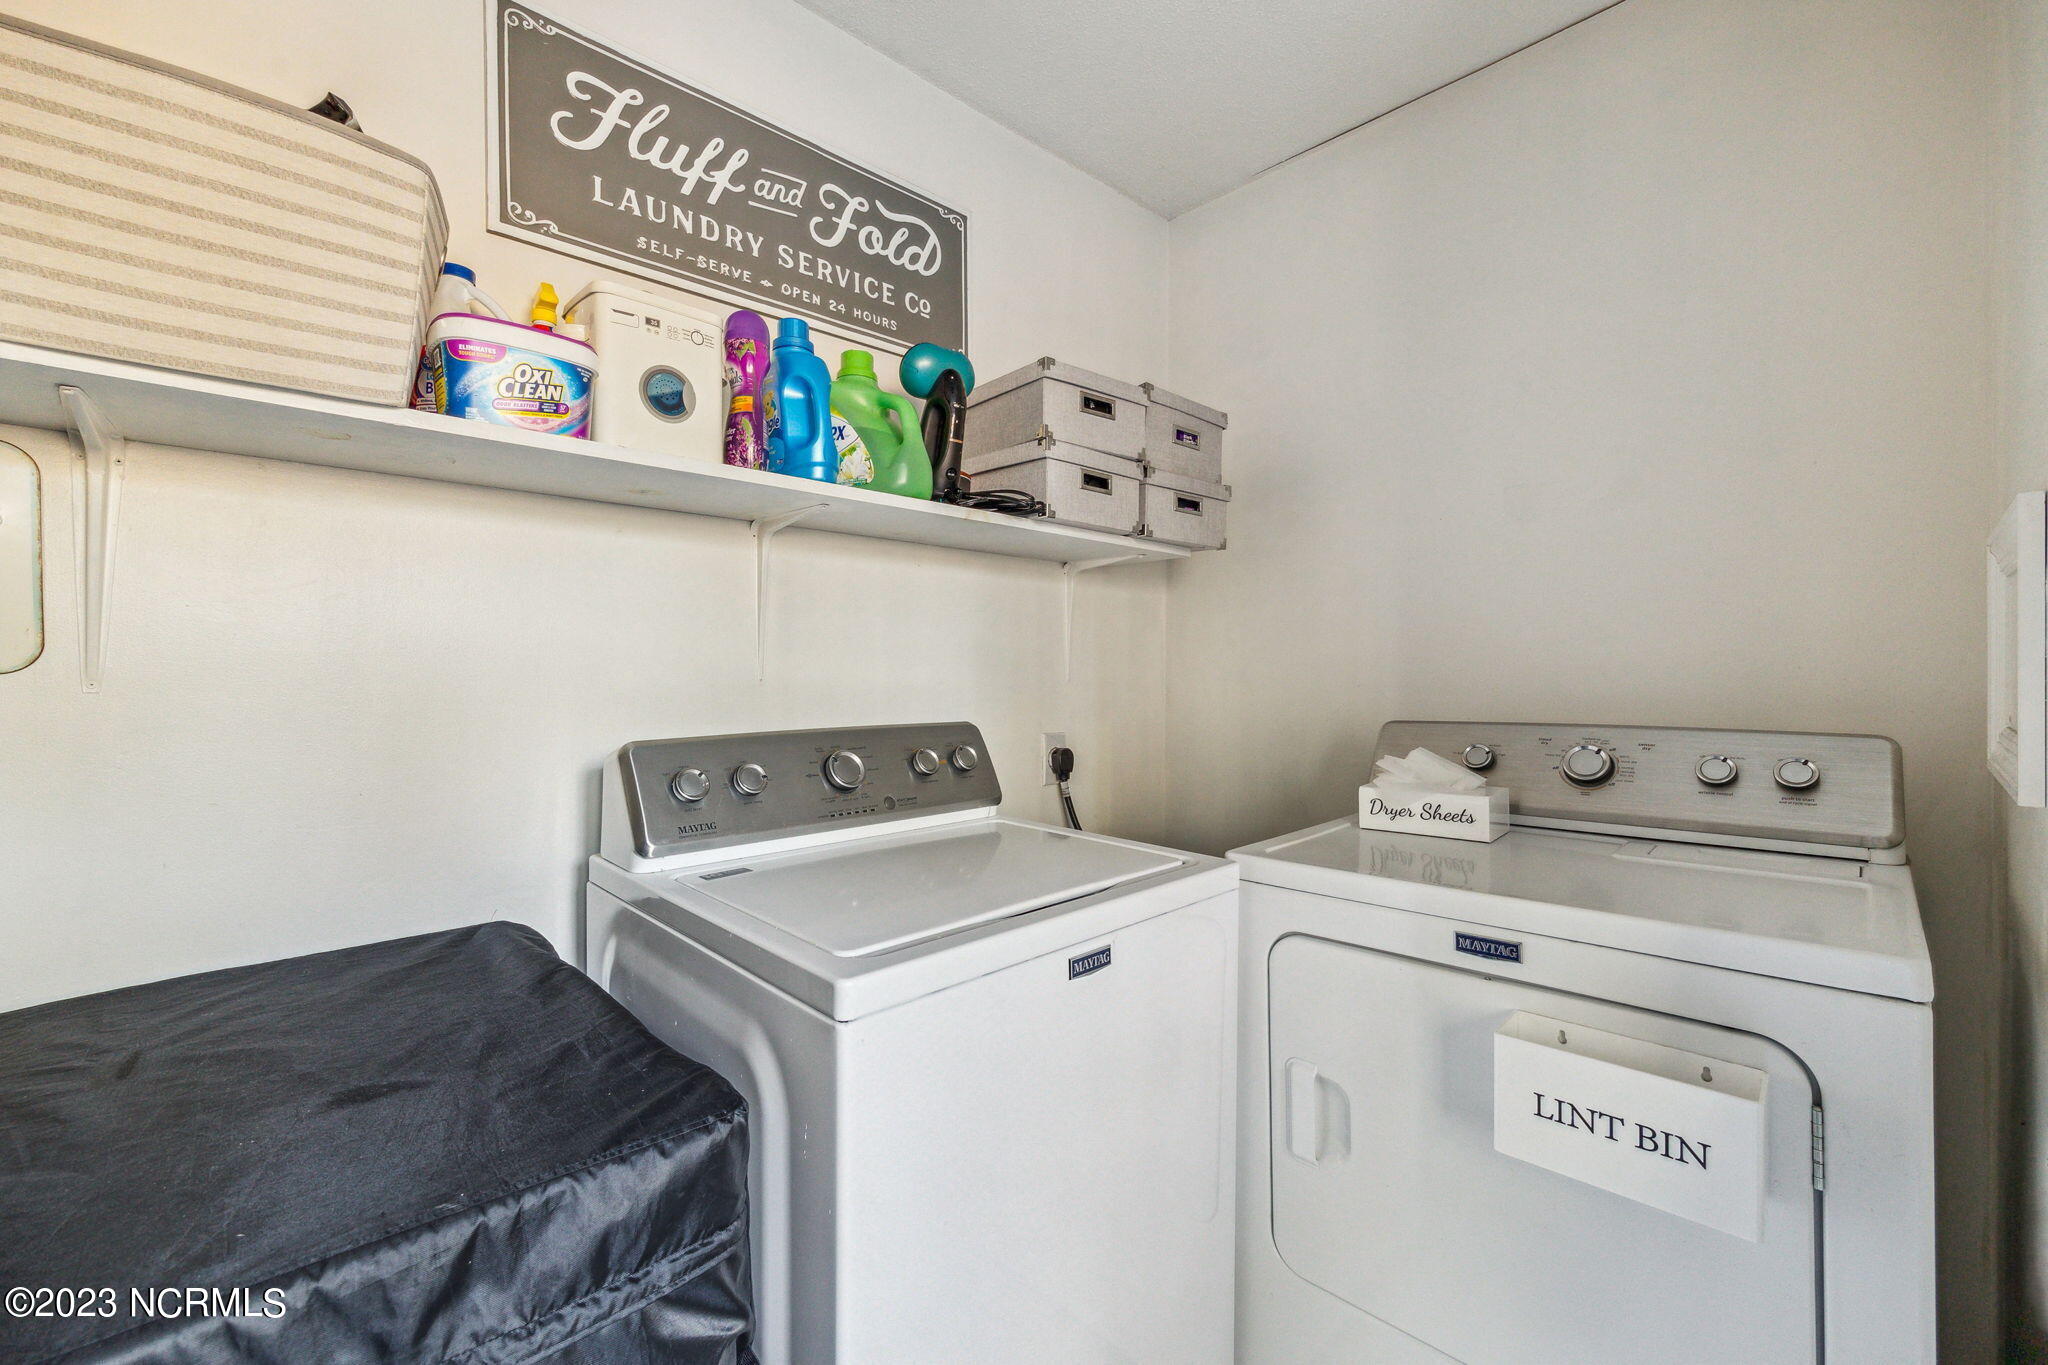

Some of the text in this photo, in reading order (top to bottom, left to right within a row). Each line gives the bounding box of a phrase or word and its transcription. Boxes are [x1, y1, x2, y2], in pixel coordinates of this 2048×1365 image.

[550, 71, 942, 277] Fluff and Fold
[592, 175, 764, 258] LAUNDRY
[777, 244, 895, 307] SERVICE
[635, 236, 898, 332] SELF-SERVE OPEN 24 HOURS
[513, 363, 553, 386] OXI
[497, 377, 564, 402] CLEAN
[1370, 798, 1476, 825] Dryer Sheets
[678, 821, 717, 835] MAYTAG
[1458, 936, 1518, 959] MAYTAG
[1073, 951, 1110, 974] MAYTAG
[1533, 1092, 1711, 1171] LINT BIN
